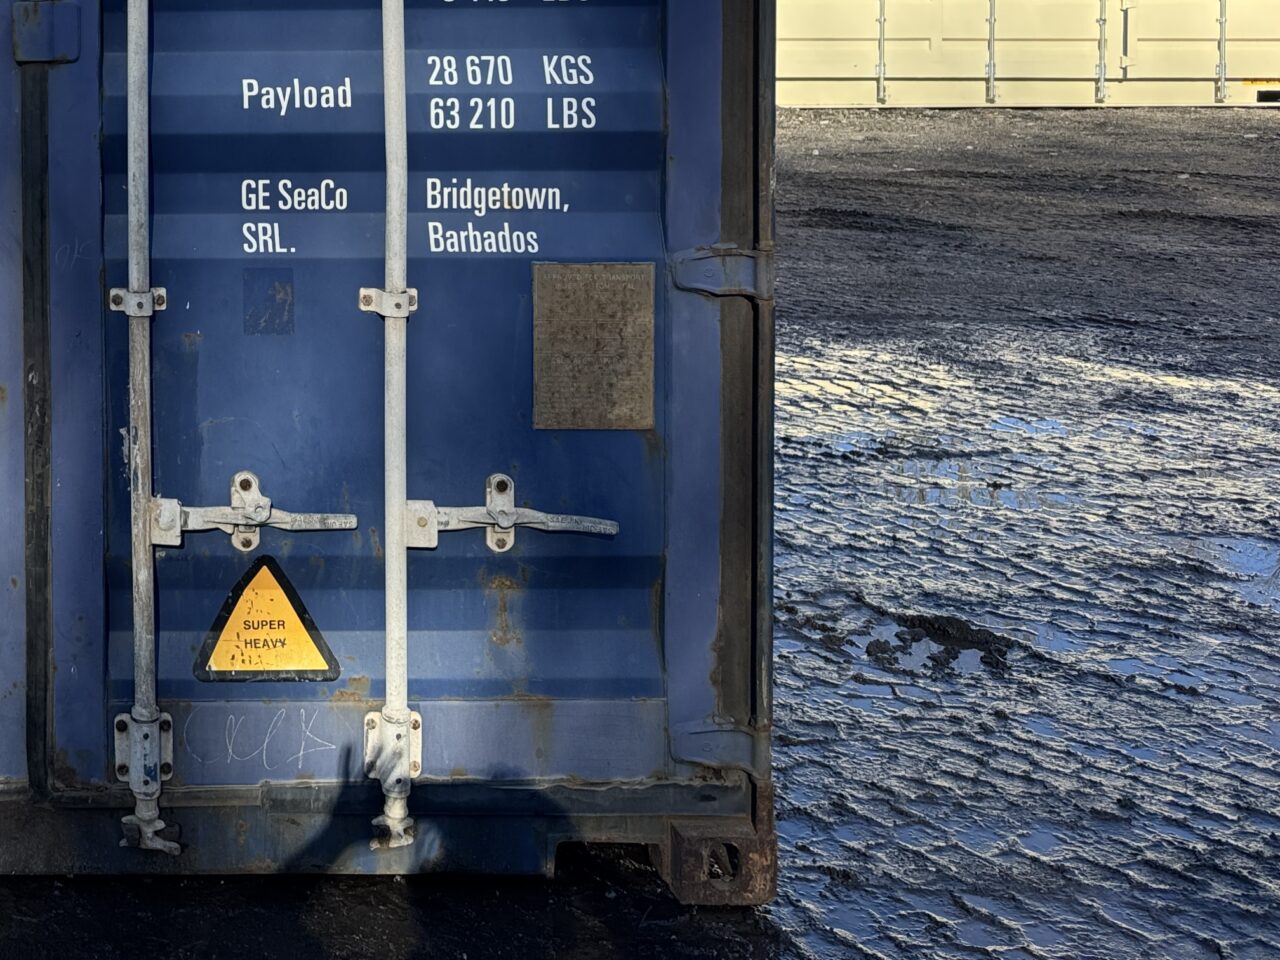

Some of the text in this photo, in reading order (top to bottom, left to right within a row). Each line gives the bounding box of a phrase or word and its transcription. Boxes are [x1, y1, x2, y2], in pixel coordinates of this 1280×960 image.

[427, 54, 595, 86] 28 670 KGS
[242, 77, 352, 116] Payload
[429, 97, 597, 129] 63 210 LBS
[241, 179, 348, 211] GE SeaCo
[426, 177, 569, 217] Bridgetown,
[242, 223, 296, 254] SRL.
[428, 222, 539, 254] Barbados
[243, 620, 286, 630] SUPER
[244, 638, 287, 649] HEAVY
